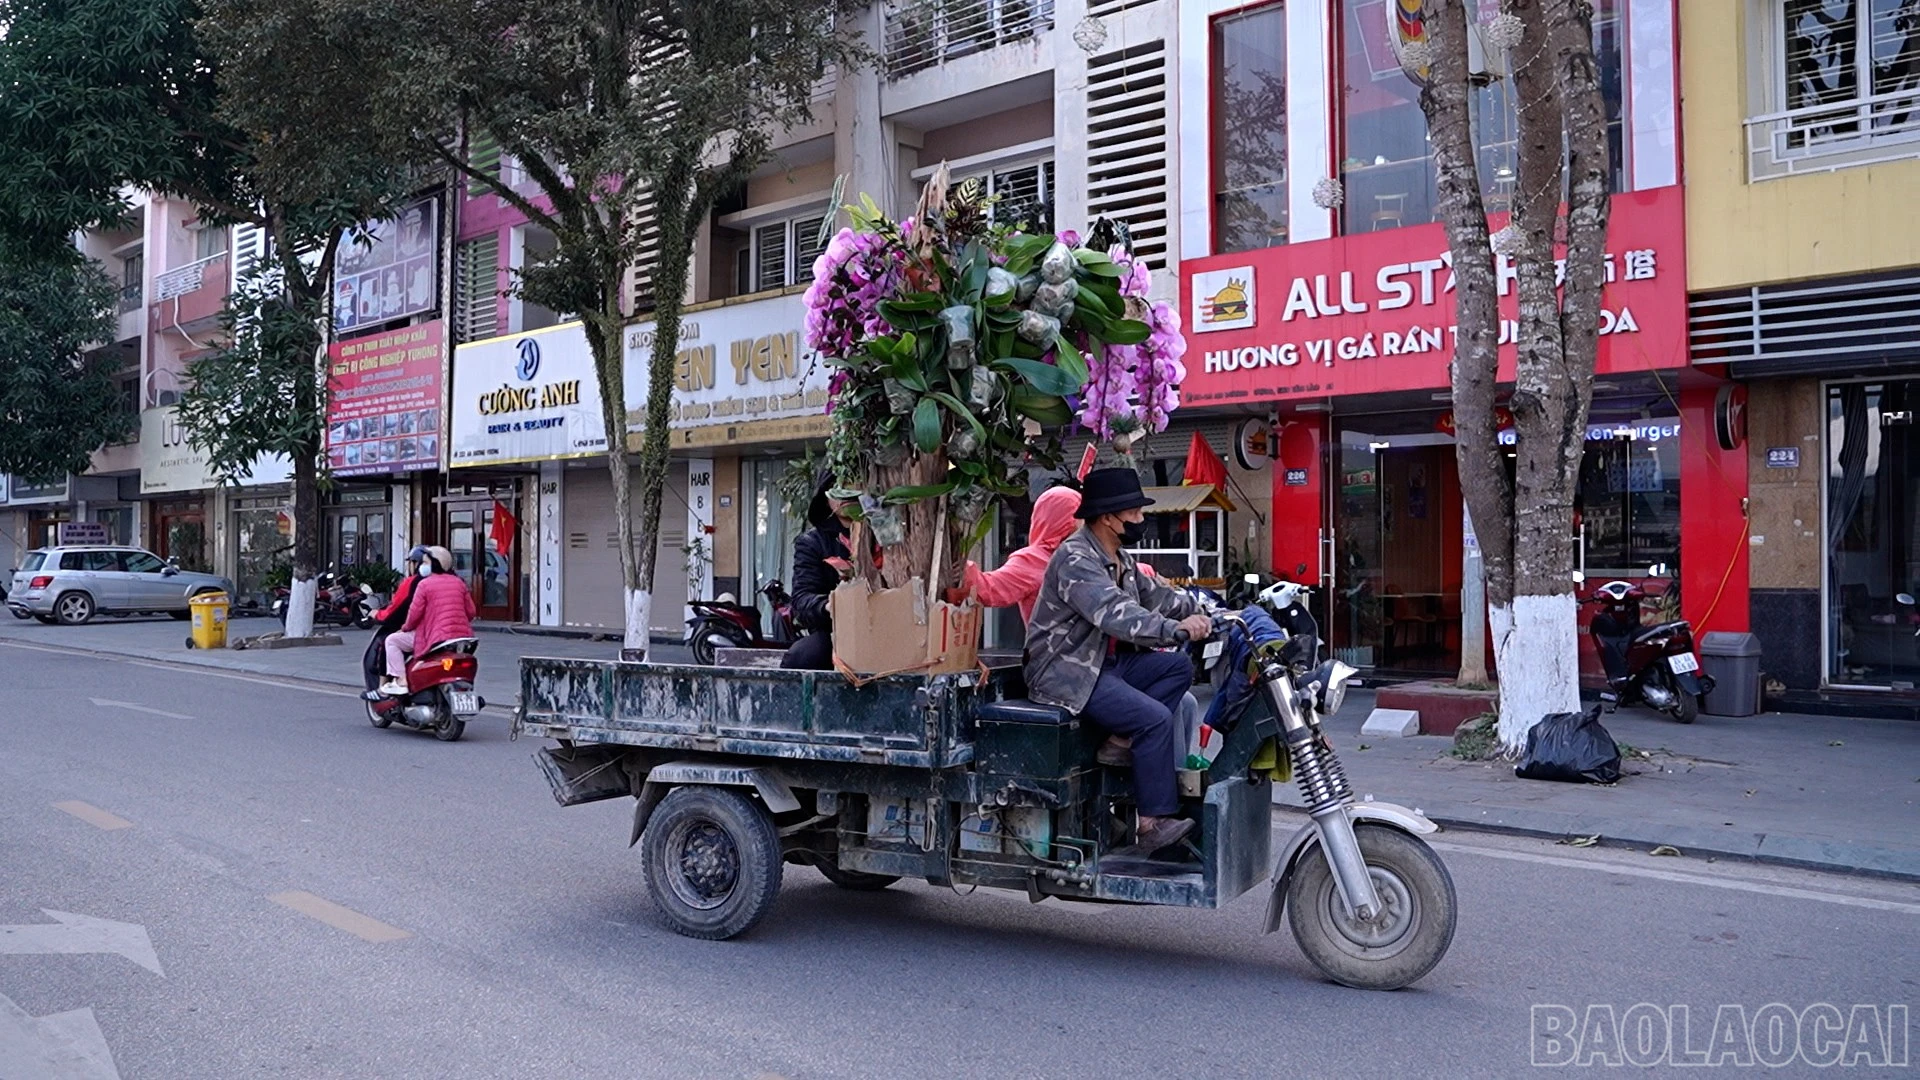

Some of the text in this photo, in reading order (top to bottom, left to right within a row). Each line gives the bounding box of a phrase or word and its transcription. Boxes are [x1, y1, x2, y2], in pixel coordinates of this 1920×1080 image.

[1282, 271, 1369, 322] ALL
[1205, 342, 1299, 374] HƯƠNG
[1305, 338, 1335, 368] VỊ
[1599, 306, 1639, 336] OA
[730, 331, 799, 385] YEN
[477, 379, 580, 416] CƯỜNG ANH
[524, 416, 565, 431] BEAUTY
[1769, 450, 1795, 461] 224
[690, 471, 711, 487] HAIR
[1287, 471, 1306, 480] 226
[541, 481, 558, 495] HAIR
